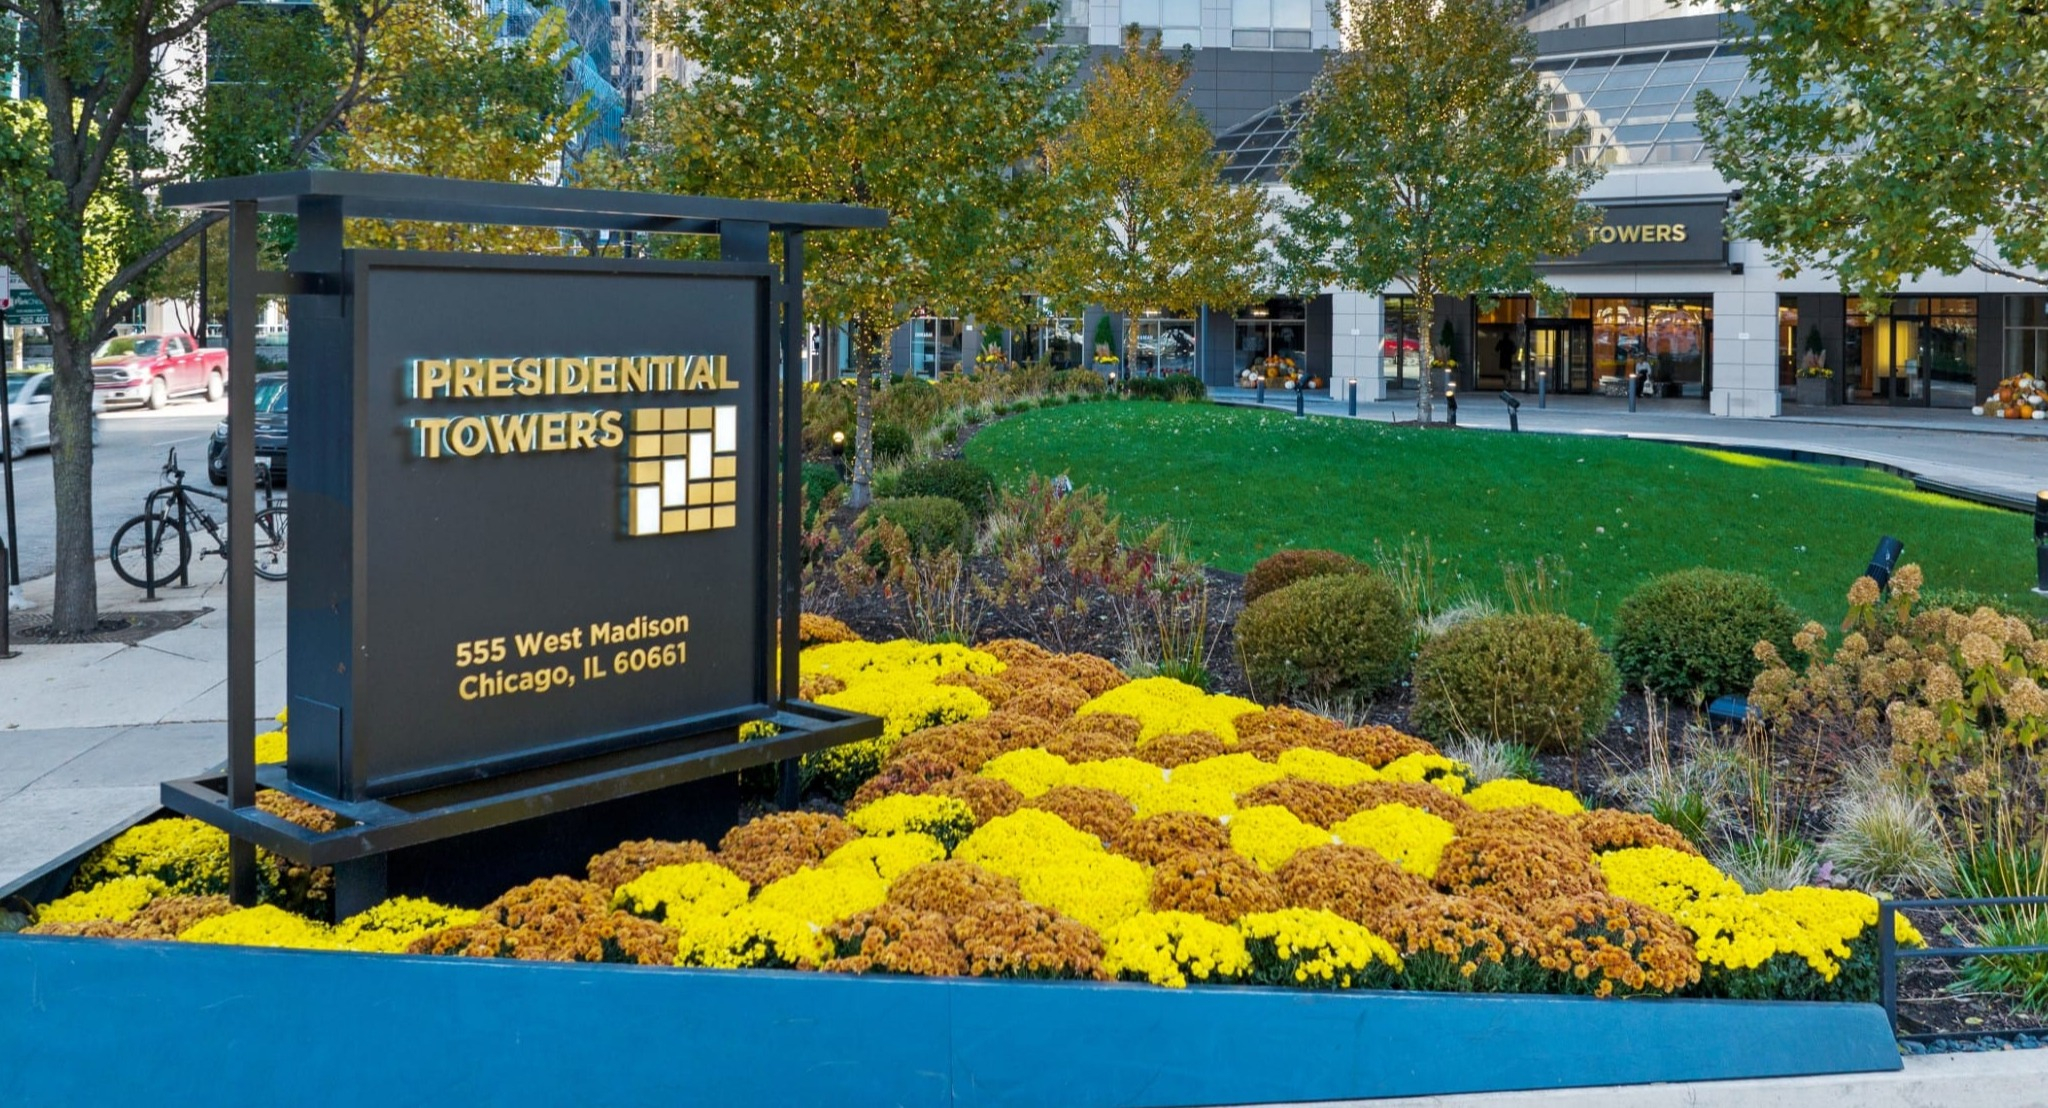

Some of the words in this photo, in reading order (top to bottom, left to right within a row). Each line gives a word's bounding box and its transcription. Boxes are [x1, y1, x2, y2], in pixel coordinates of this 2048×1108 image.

[1588, 223, 1687, 244] TOWERS
[414, 355, 740, 399] PRESIDENTIAL
[411, 409, 624, 458] TOWERS
[456, 637, 507, 667] 555
[515, 627, 582, 658] West
[590, 614, 690, 646] Madison
[458, 666, 575, 700] Chicago,
[584, 655, 607, 680] IL
[613, 641, 687, 674] 60661
